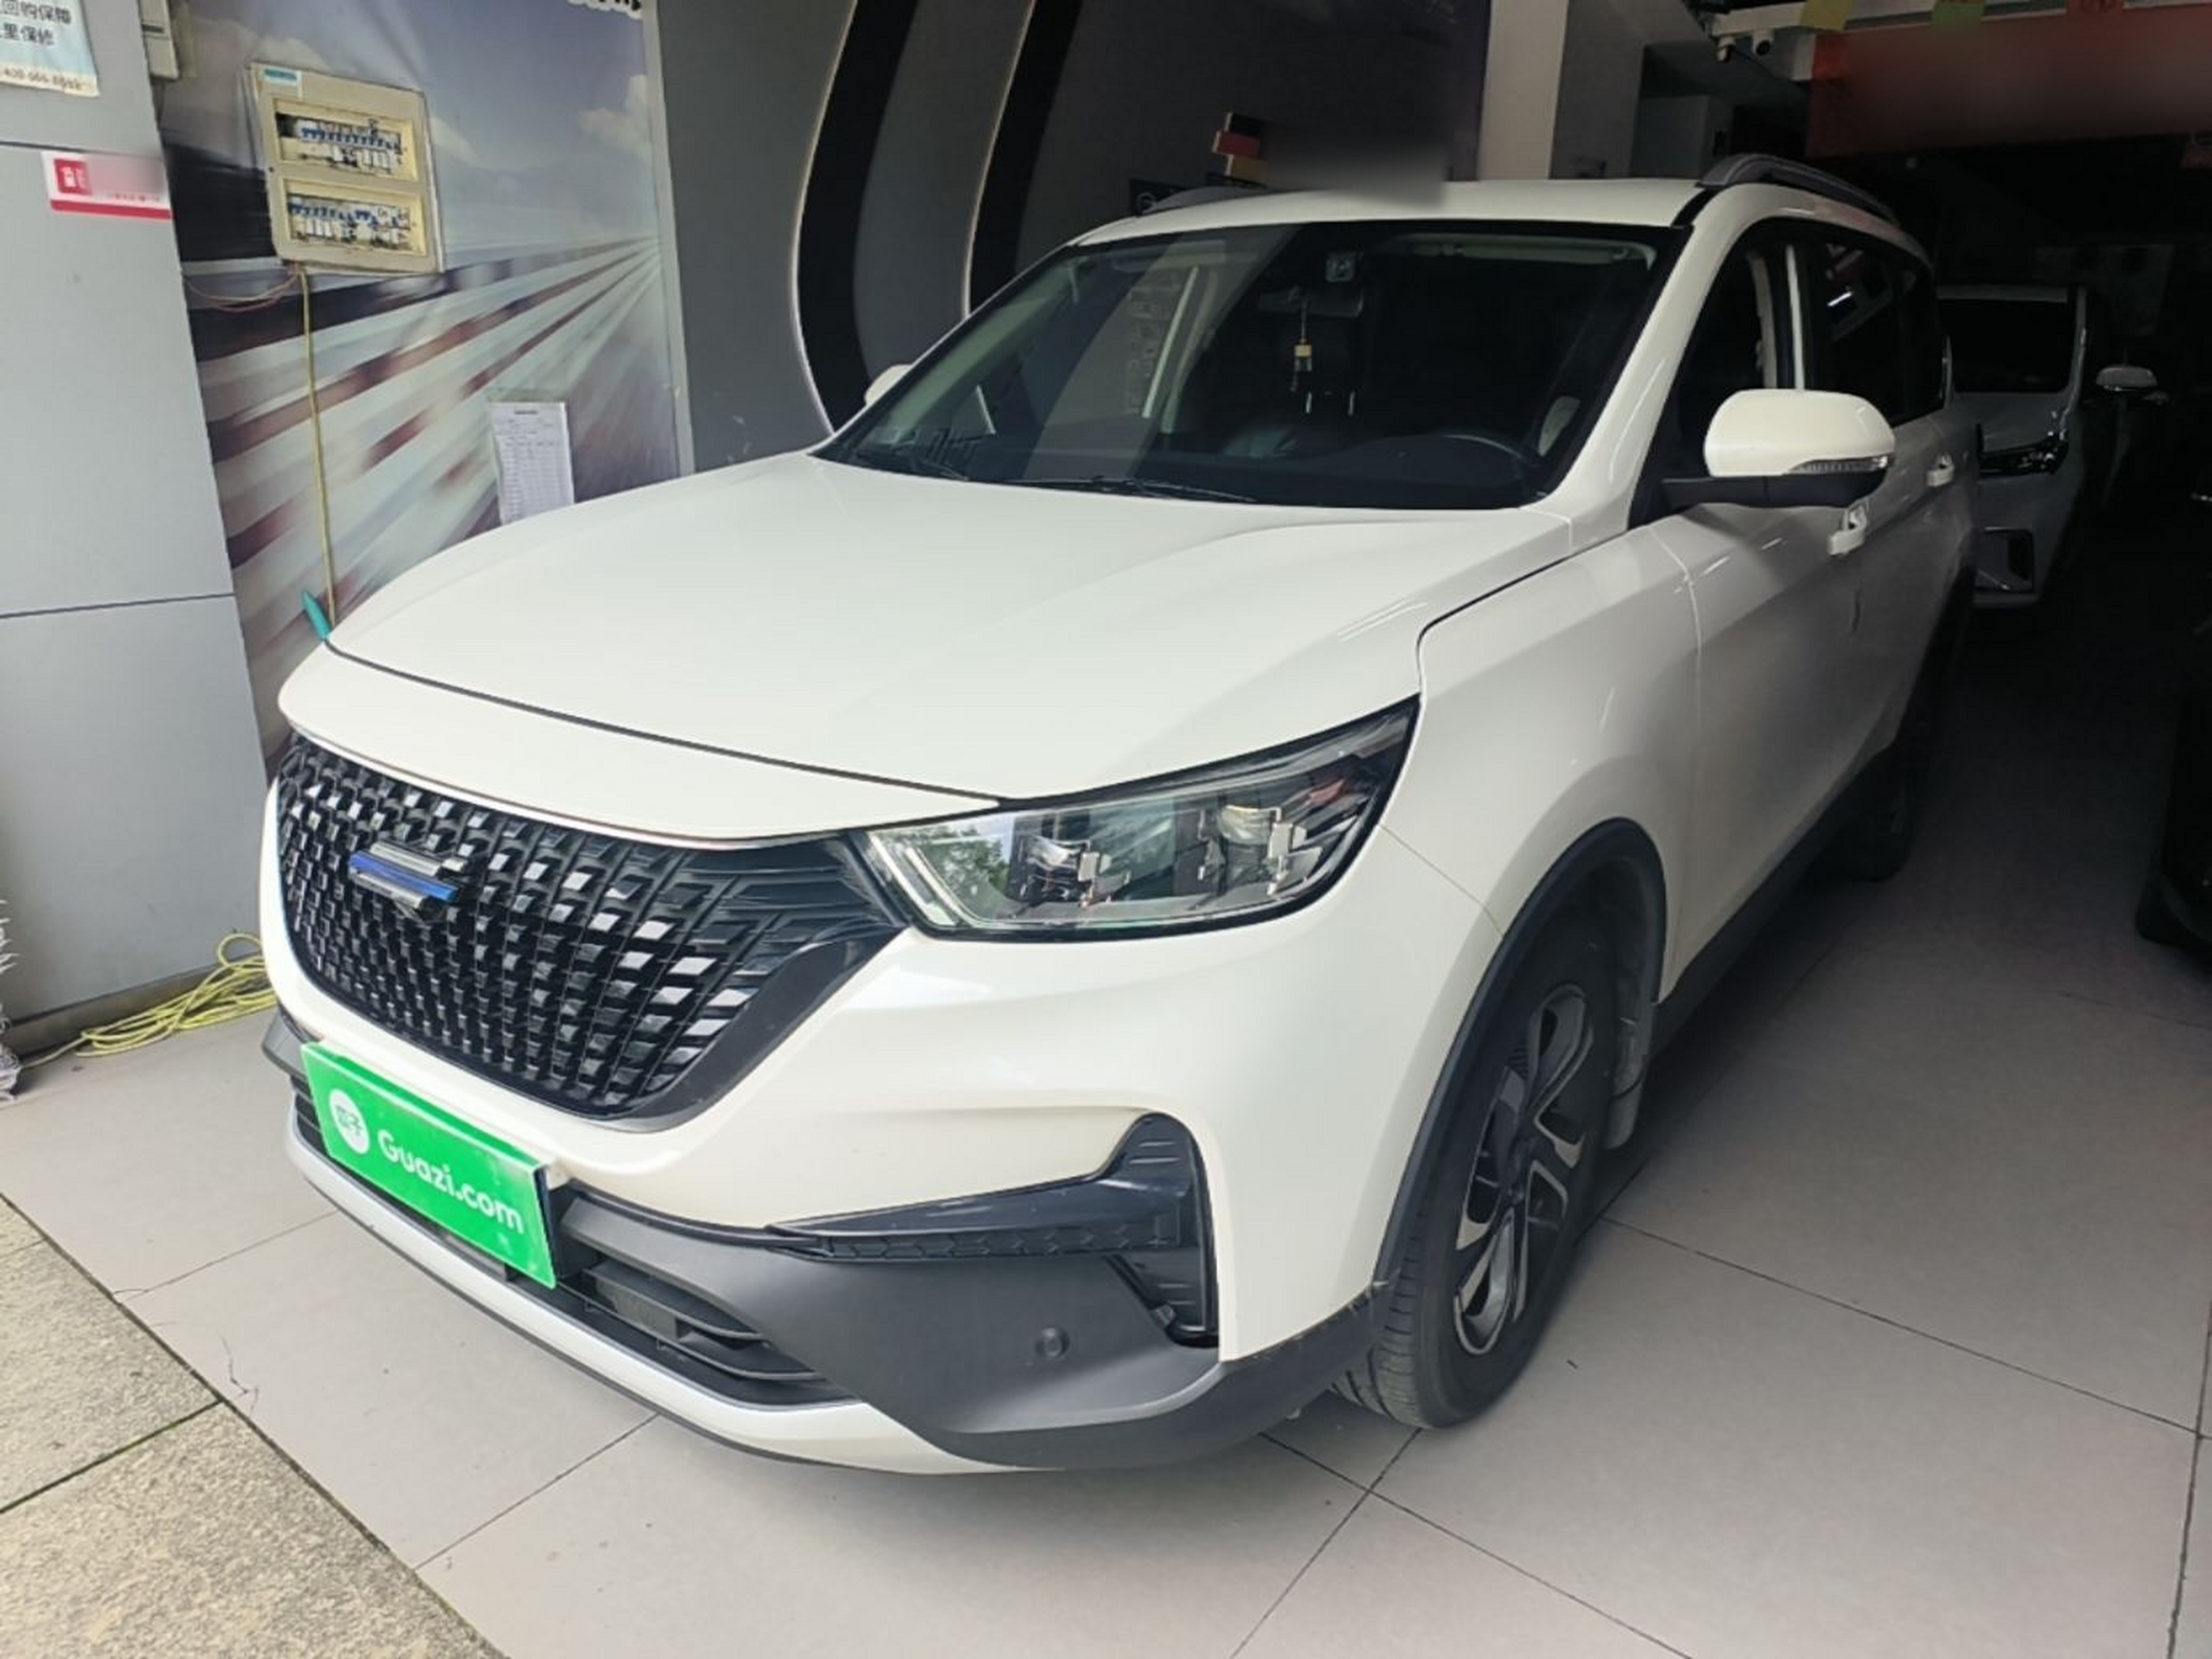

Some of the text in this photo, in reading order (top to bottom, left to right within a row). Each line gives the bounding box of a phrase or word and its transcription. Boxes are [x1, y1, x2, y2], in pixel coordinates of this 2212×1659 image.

[0, 0, 72, 25] 回购保障
[0, 22, 55, 46] 里保修
[377, 1129, 524, 1234] Guazi.com
